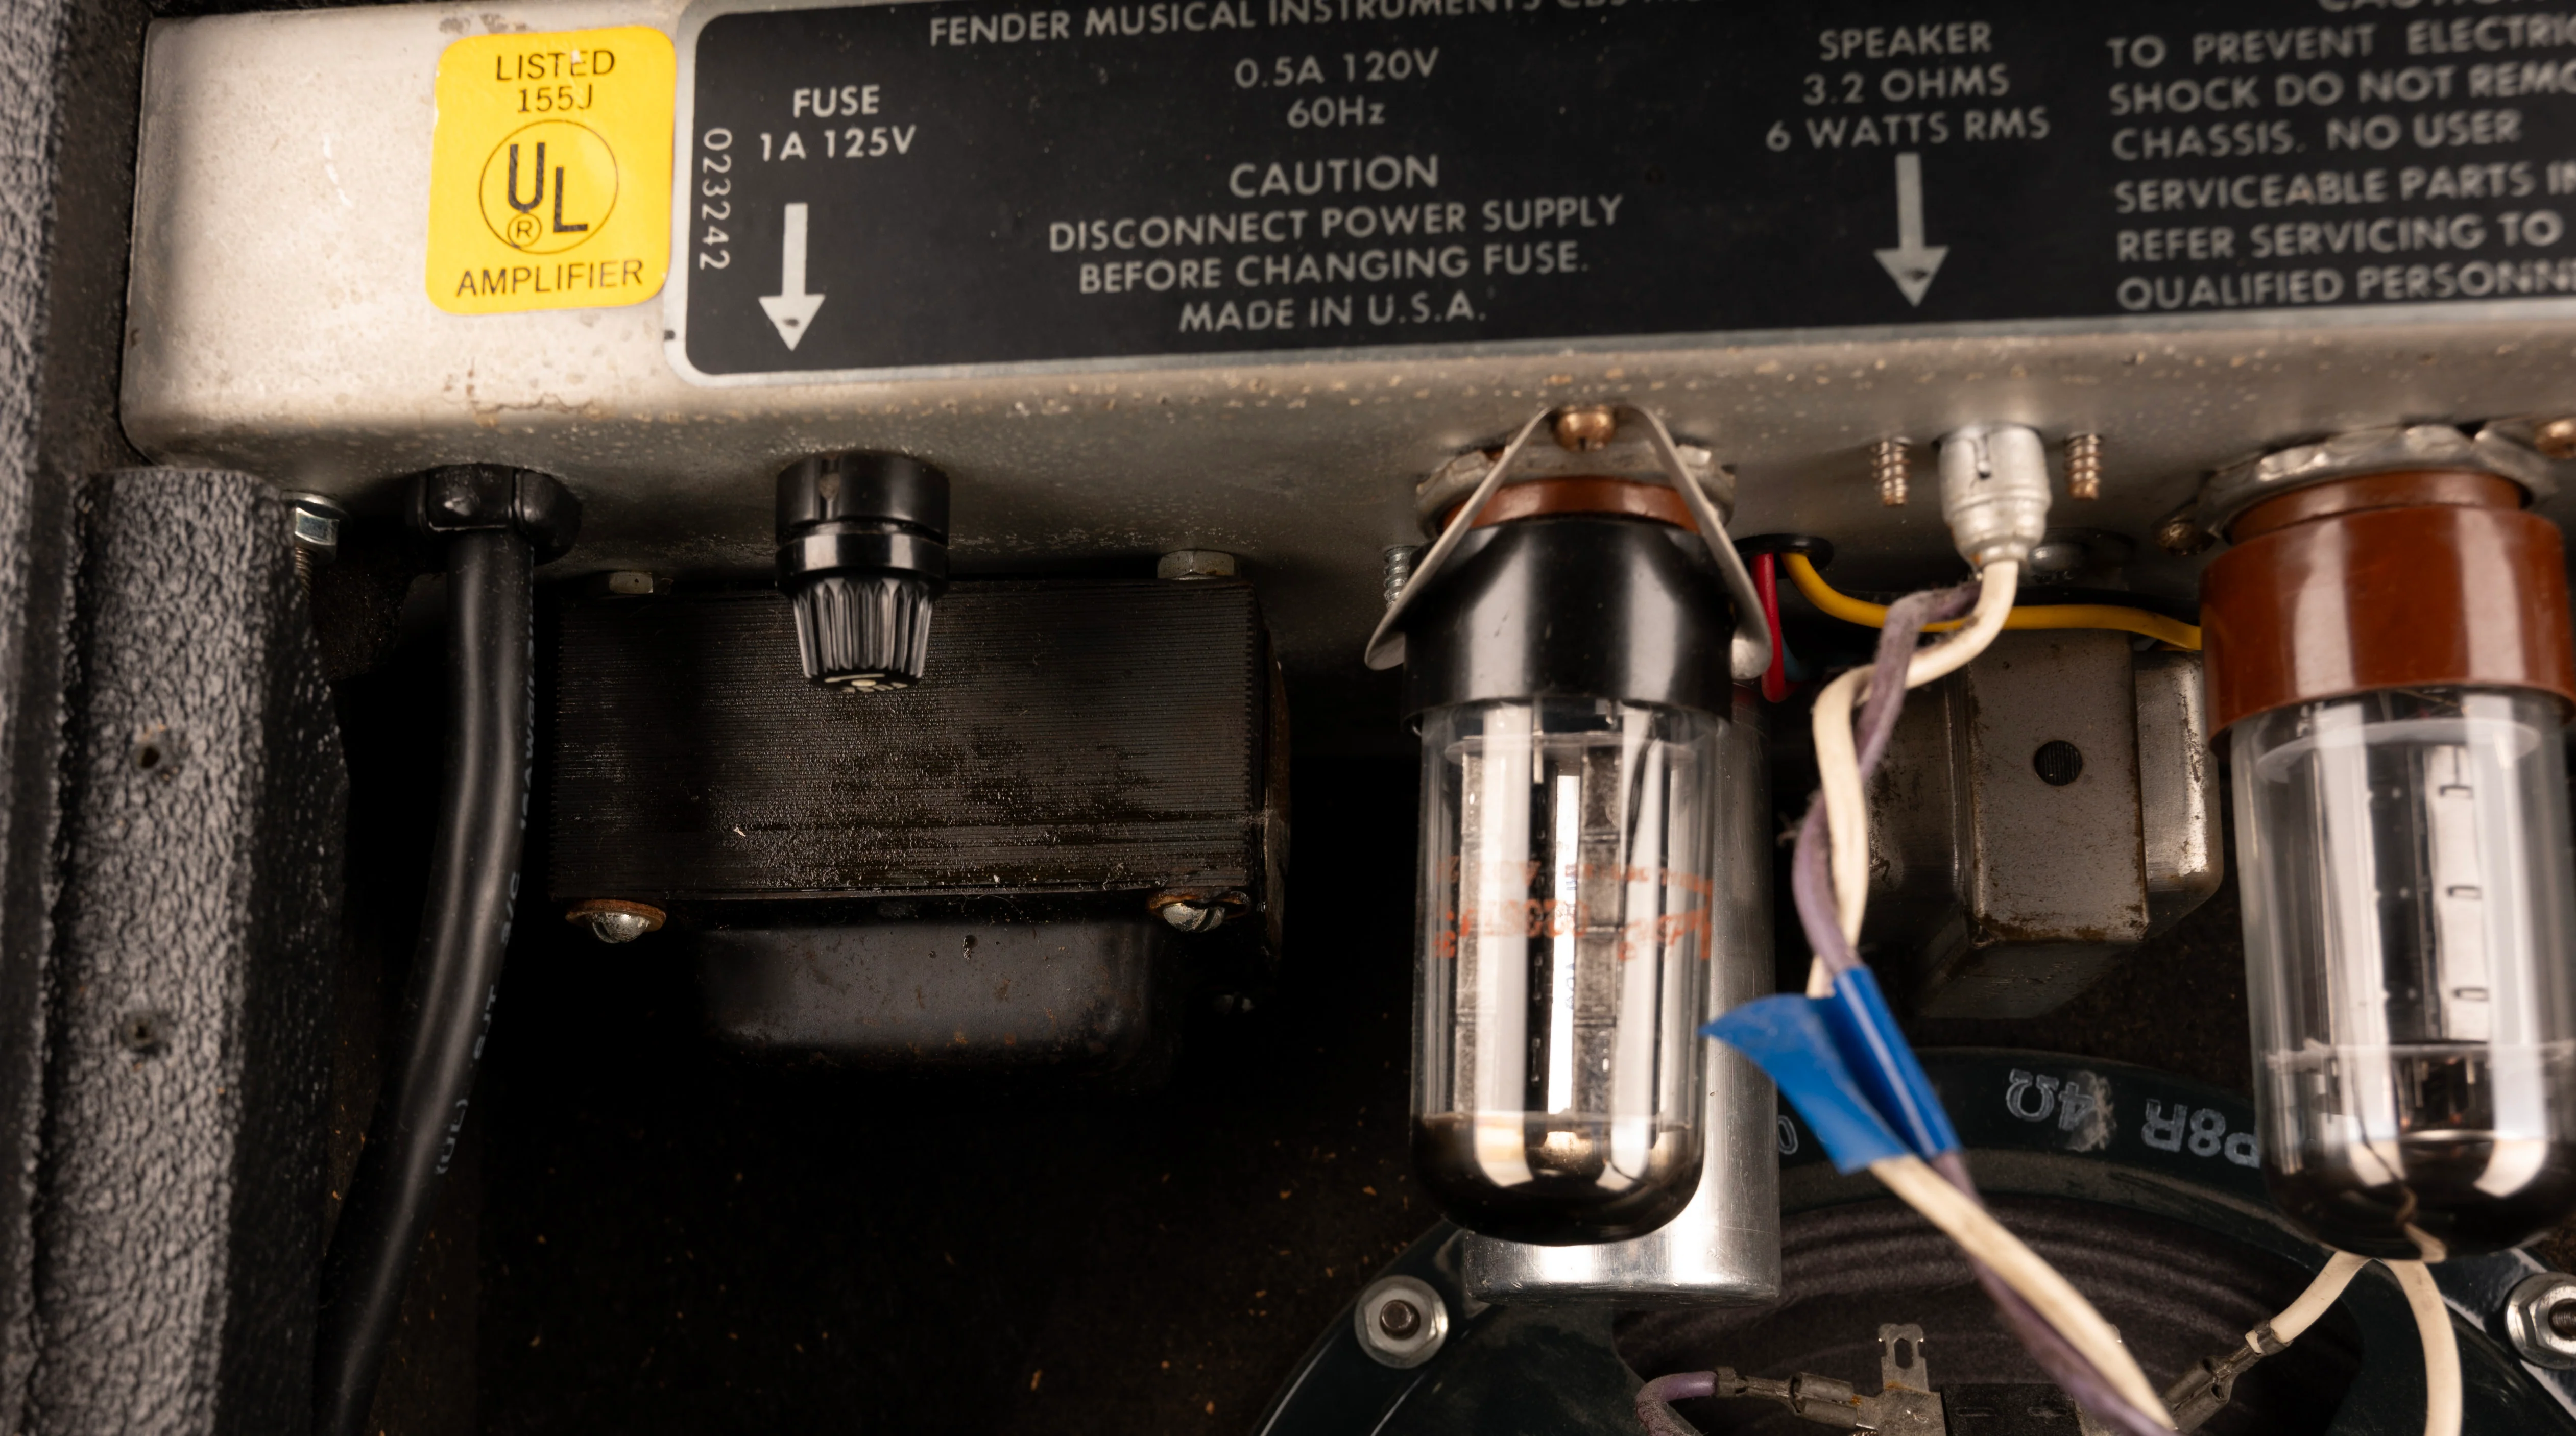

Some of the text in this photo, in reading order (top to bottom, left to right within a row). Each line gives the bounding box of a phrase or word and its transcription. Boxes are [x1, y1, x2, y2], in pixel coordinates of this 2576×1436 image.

[931, 11, 1070, 46] FENDER
[1084, 0, 1255, 36] MUSICAL
[1820, 22, 1991, 60] SPEAKER
[496, 50, 615, 81] LISTED
[1235, 47, 1438, 88] 0.5A 120V
[2107, 35, 2166, 68] TO
[2193, 23, 2375, 64] PREVENT
[518, 83, 593, 113] 155J
[793, 85, 879, 118] FUSE
[1803, 63, 2009, 105] 3.2 OHMS
[2109, 77, 2259, 115] SHOCK
[2276, 71, 2344, 106] DO
[2359, 66, 2454, 102] NOT
[1287, 96, 1384, 128] 60Hz
[1766, 106, 2049, 151] 6 WATTS RMS
[761, 125, 916, 161] 1A 125V
[2112, 109, 2521, 160] CHASSIS. NO USER
[1230, 155, 1437, 198] CAUTION
[2115, 169, 2387, 213] SERVICEABLE
[2400, 162, 2535, 199] PARTS
[700, 128, 732, 270] 023242
[1049, 195, 1622, 252] DISCONNECT POWER SUPPLY
[2117, 210, 2563, 261] REFER SERVICING TO
[456, 259, 643, 297] AMPLIFIER
[1080, 241, 1586, 294] BEFORE CHANGING FUSE.
[2118, 259, 2576, 309] QUALIFIED PERSONN
[1179, 290, 1485, 332] MADE IN U.S.A.
